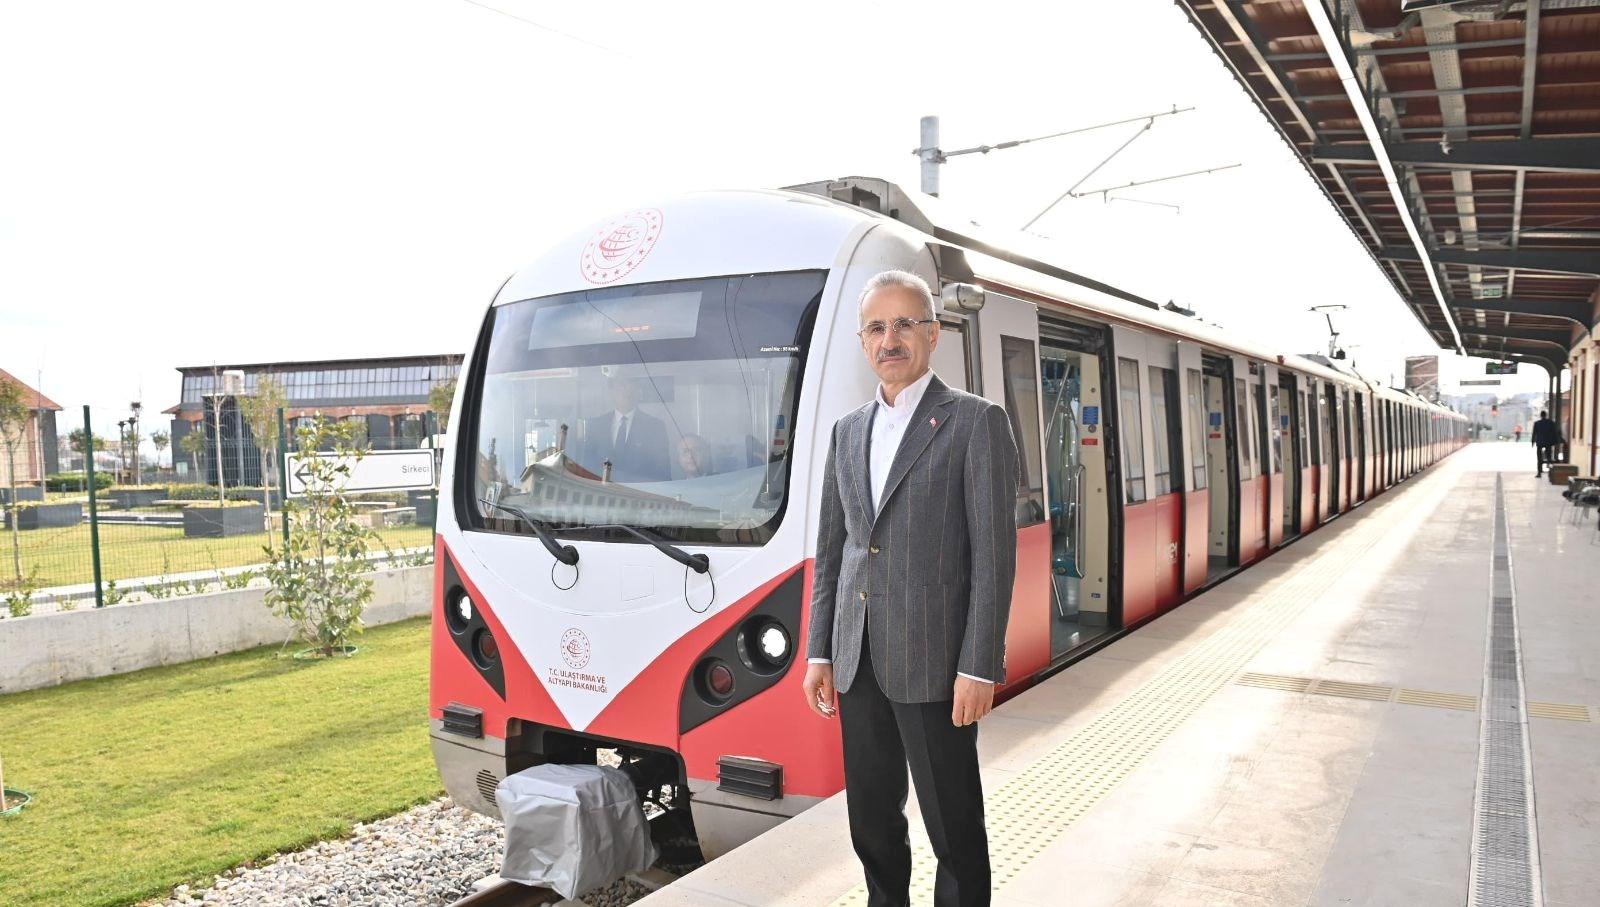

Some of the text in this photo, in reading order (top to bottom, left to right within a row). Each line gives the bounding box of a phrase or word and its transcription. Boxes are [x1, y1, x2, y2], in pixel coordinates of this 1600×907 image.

[401, 464, 430, 474] Sirkeci
[548, 668, 606, 684] T.C. ULAŞTIRMA VE
[548, 677, 608, 694] ALTYAPI BAKANLIĞI
